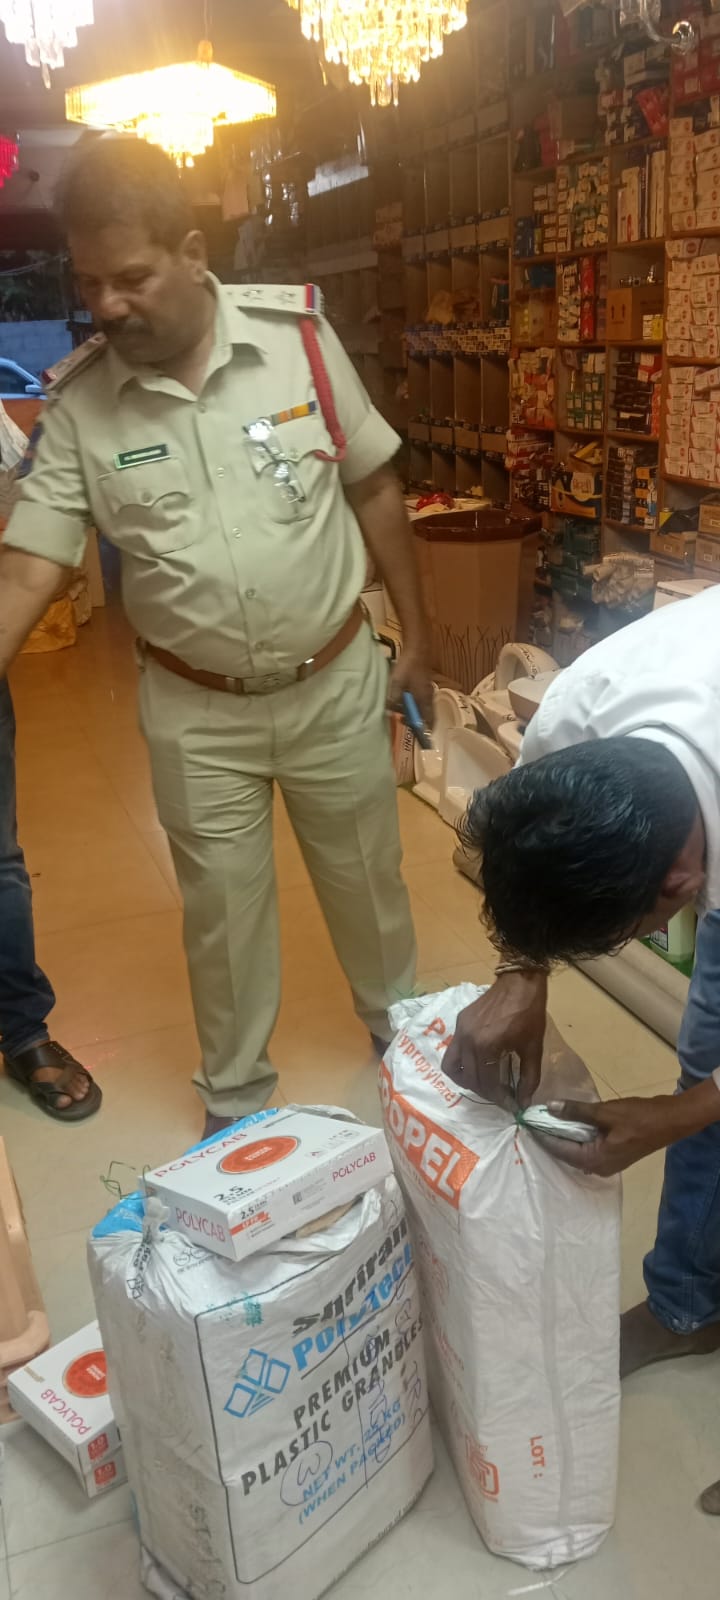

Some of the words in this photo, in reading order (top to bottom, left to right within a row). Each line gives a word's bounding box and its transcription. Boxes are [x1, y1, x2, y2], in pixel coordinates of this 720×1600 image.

[154, 1133, 247, 1178] POLYCAB
[332, 1151, 377, 1182] POLYCAB
[175, 1206, 226, 1243] POLYCAB
[240, 1206, 255, 1221] 2.5
[293, 1328, 390, 1431] PREMIUM
[40, 1388, 93, 1435] POLYCAB
[241, 1410, 331, 1496] PLASTIC
[530, 1435, 545, 1467] LOT
[303, 1465, 332, 1502] NET
